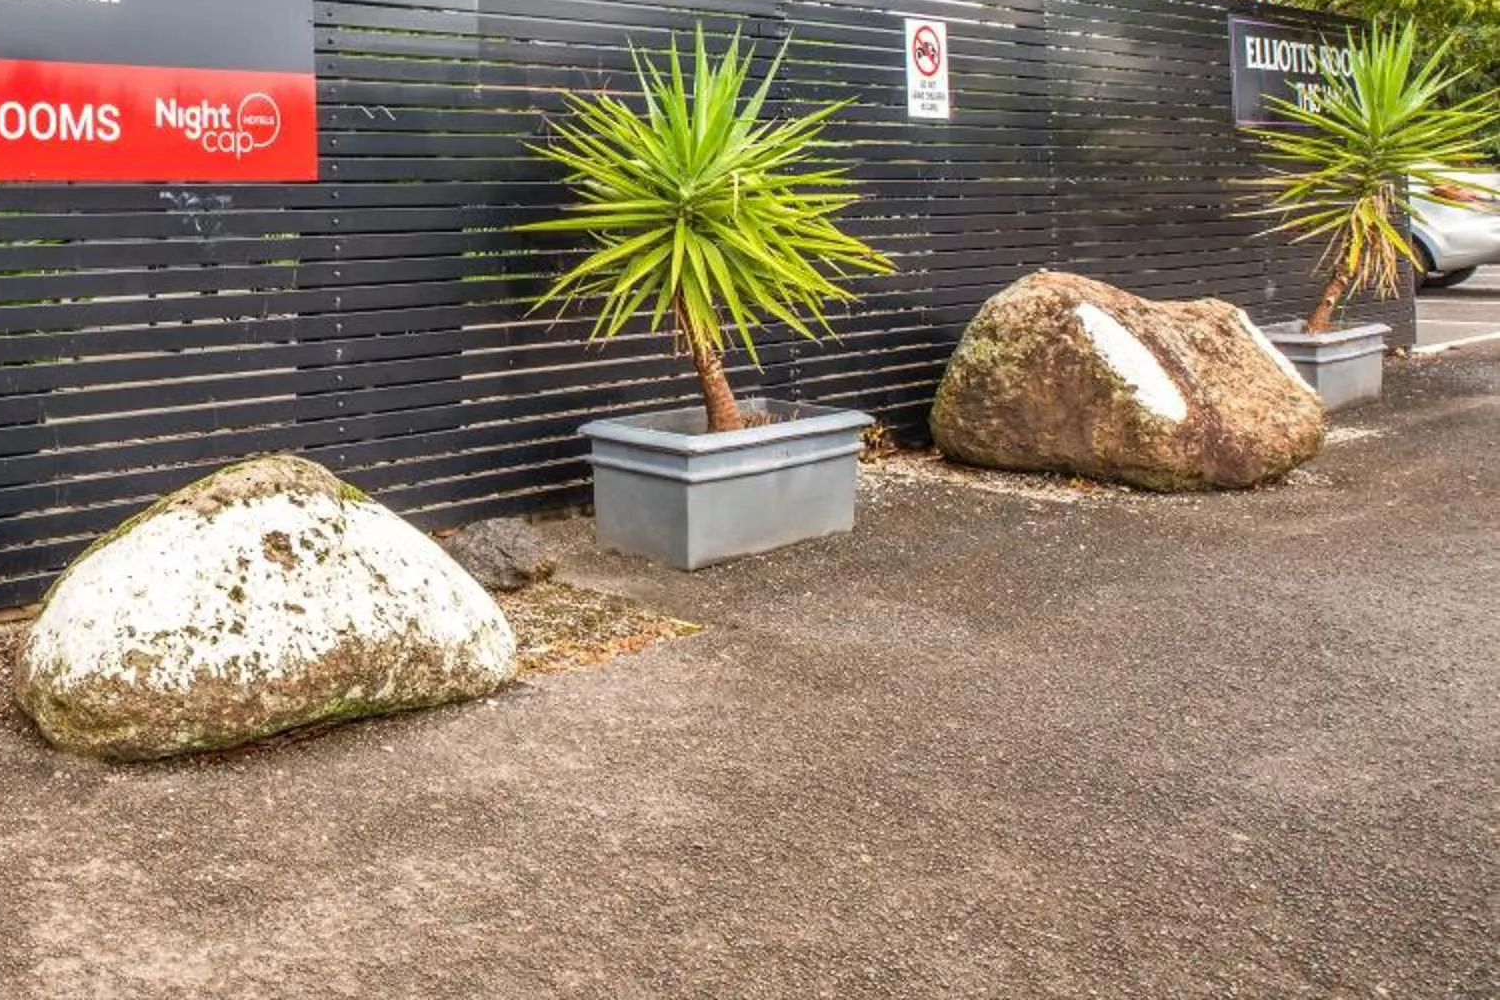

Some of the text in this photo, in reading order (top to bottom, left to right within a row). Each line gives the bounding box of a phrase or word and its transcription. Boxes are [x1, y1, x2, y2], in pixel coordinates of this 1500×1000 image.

[1245, 35, 1365, 78] ELLIOTTS ROO
[155, 96, 232, 140] Night
[202, 130, 254, 160] cap
